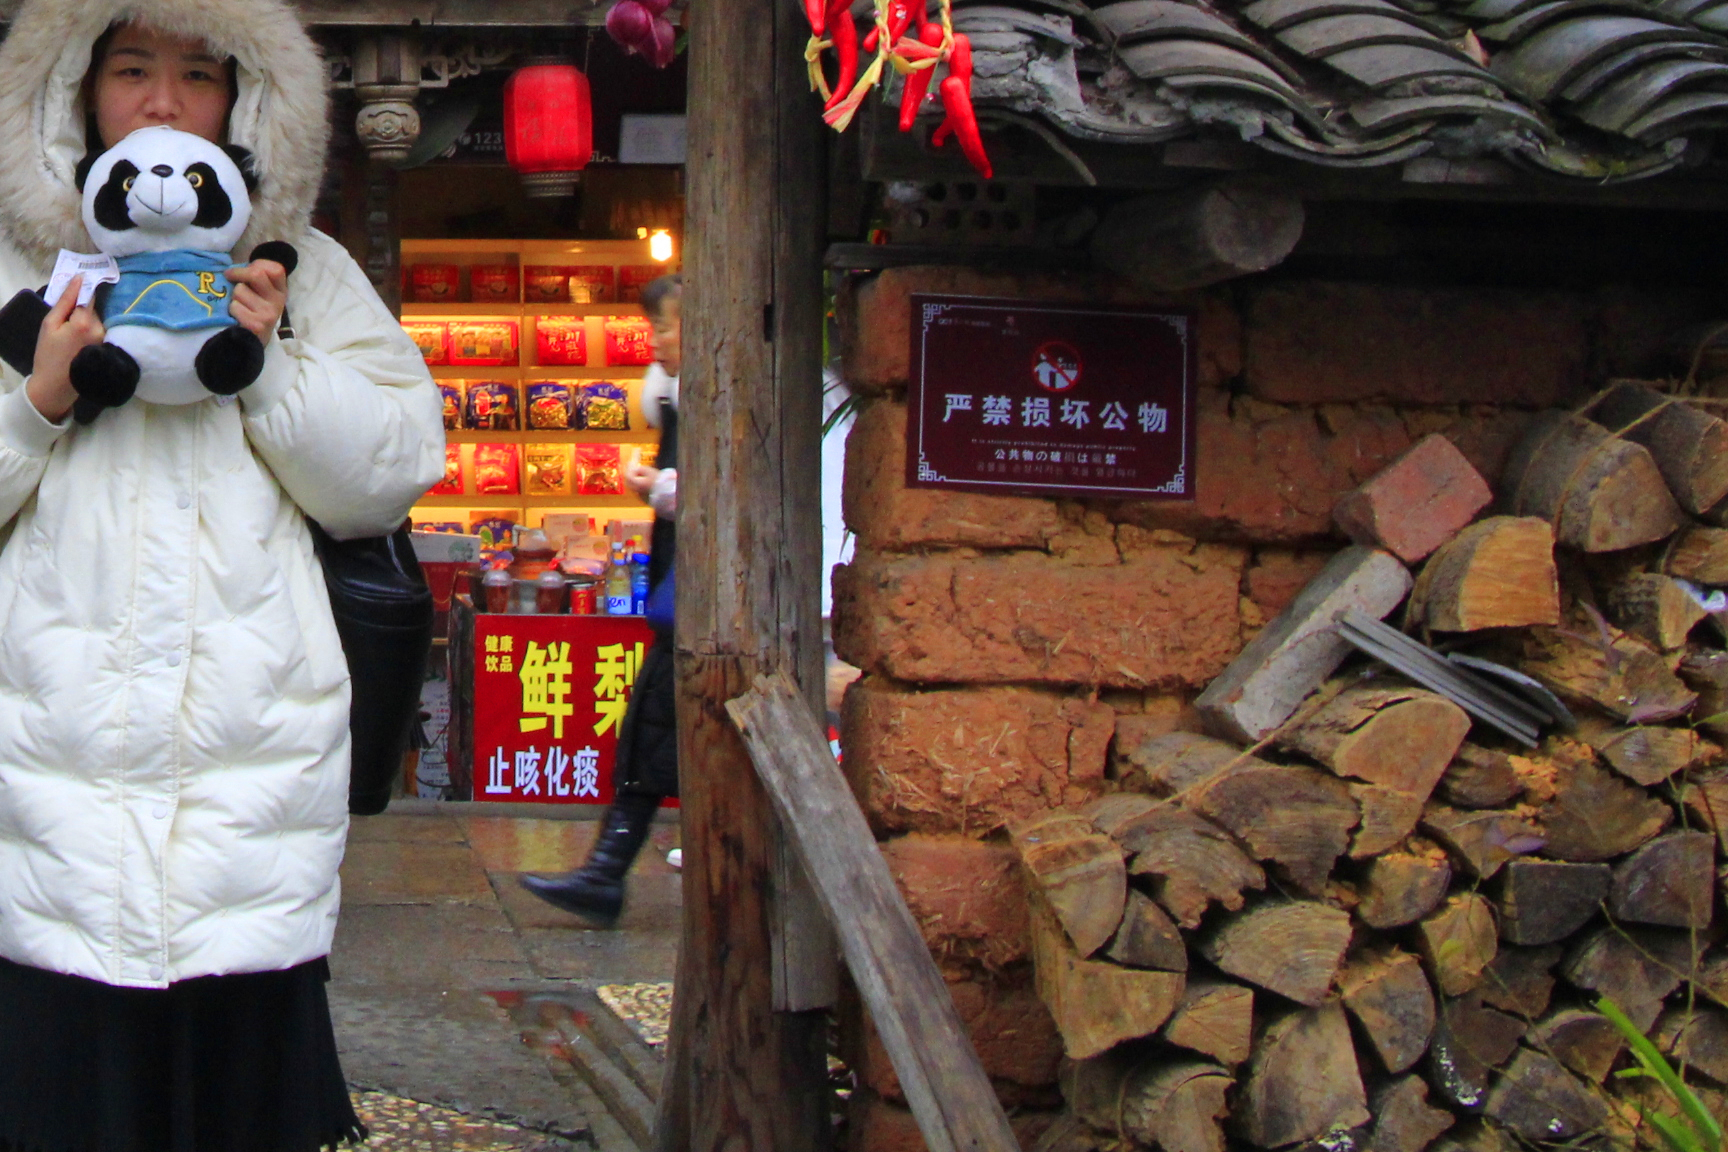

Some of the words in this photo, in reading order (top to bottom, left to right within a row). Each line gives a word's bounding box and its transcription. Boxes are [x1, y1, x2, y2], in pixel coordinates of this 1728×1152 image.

[942, 393, 1167, 433] 严禁损坏公物
[485, 634, 513, 653] 健康
[485, 655, 513, 673] 饮品
[518, 640, 645, 740] 鲜梨
[485, 746, 600, 798] 止咳化痰
